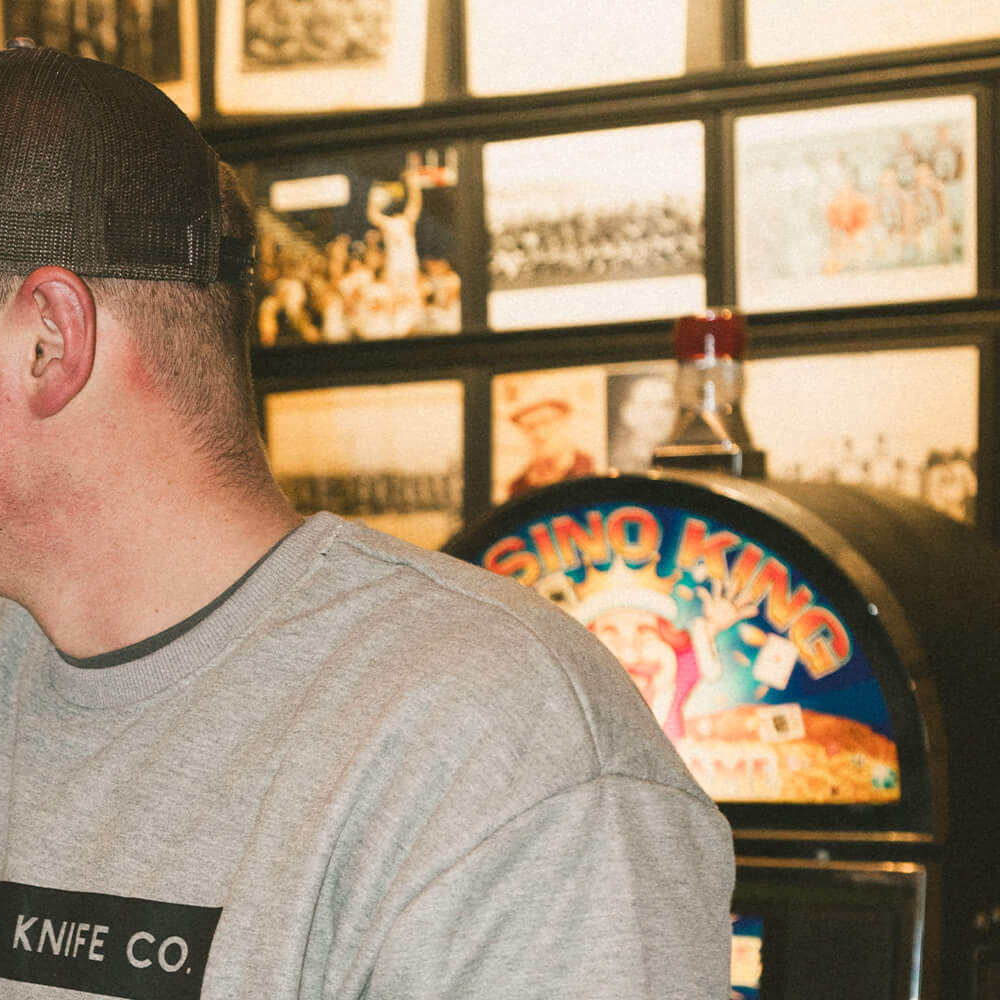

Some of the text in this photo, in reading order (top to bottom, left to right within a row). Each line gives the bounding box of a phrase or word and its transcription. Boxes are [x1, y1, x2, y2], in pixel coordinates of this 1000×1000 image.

[675, 516, 853, 680] KING
[12, 914, 110, 962] KNIFE
[126, 931, 192, 975] CO.
